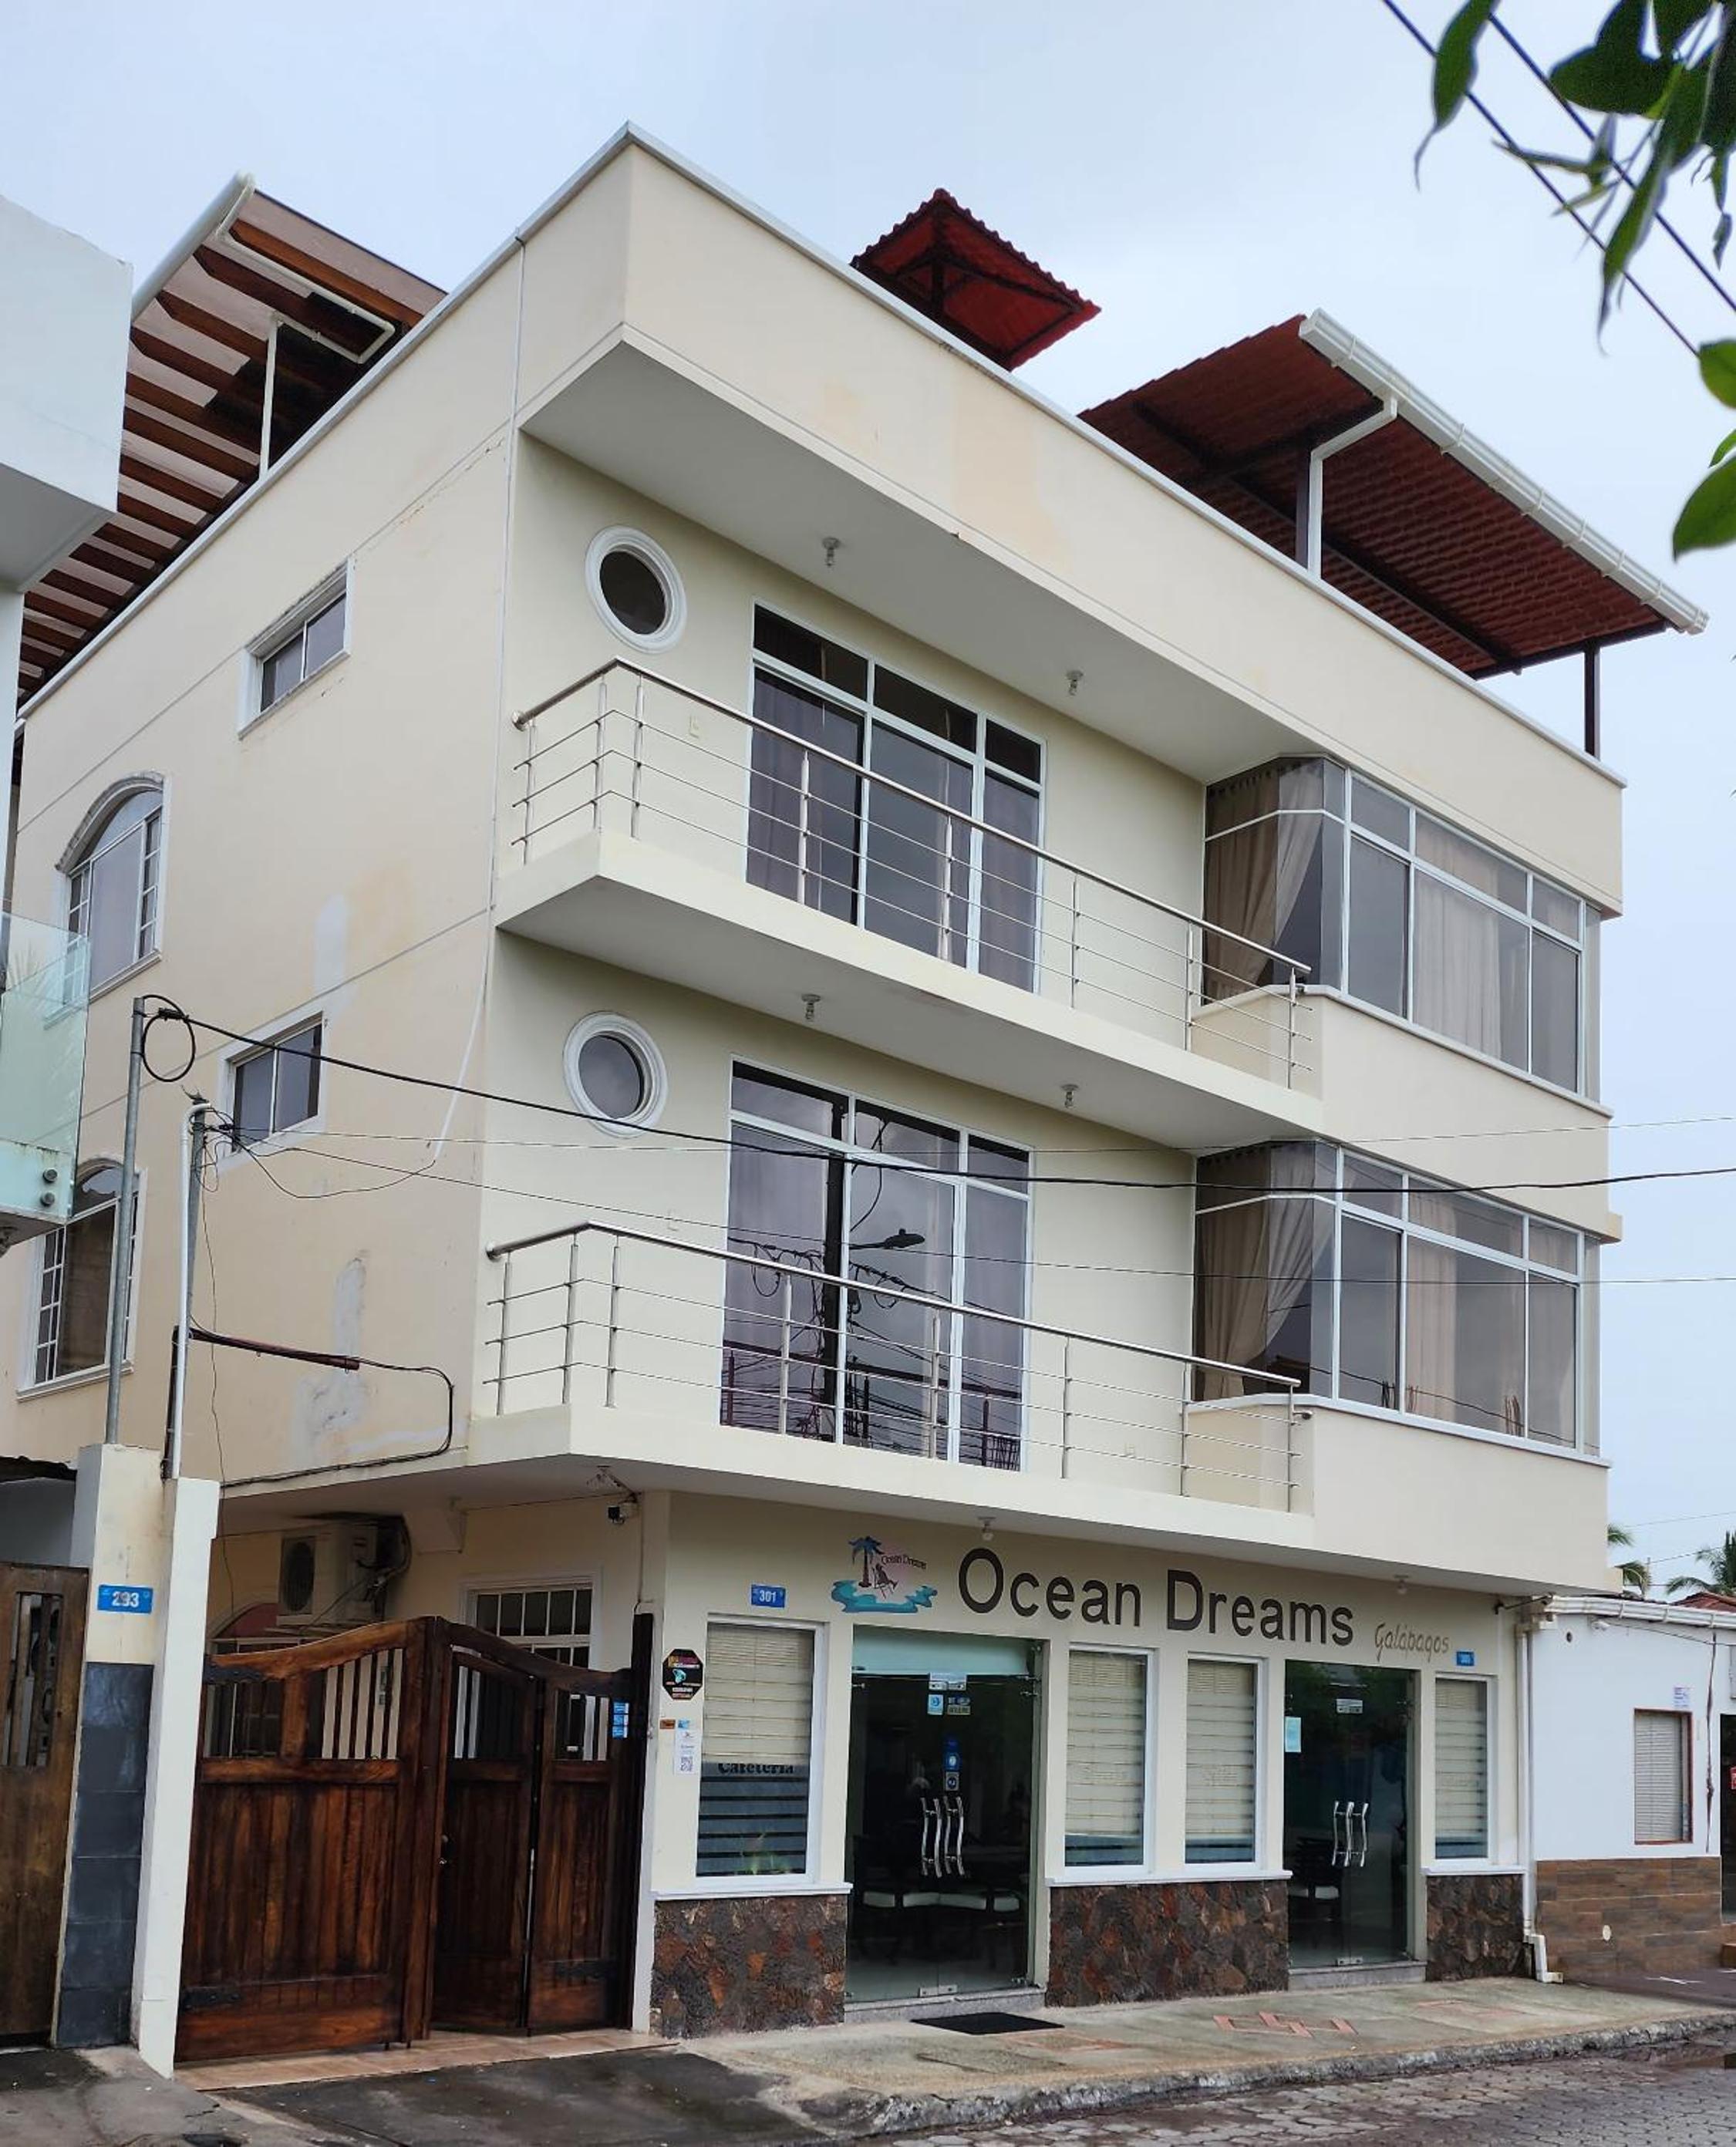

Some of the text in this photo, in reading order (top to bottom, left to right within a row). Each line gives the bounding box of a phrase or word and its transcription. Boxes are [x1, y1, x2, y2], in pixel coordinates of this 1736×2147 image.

[759, 1589, 777, 1603] 301
[959, 1548, 1353, 1646] Ocean Dreams
[1374, 1622, 1449, 1663] Galápagos
